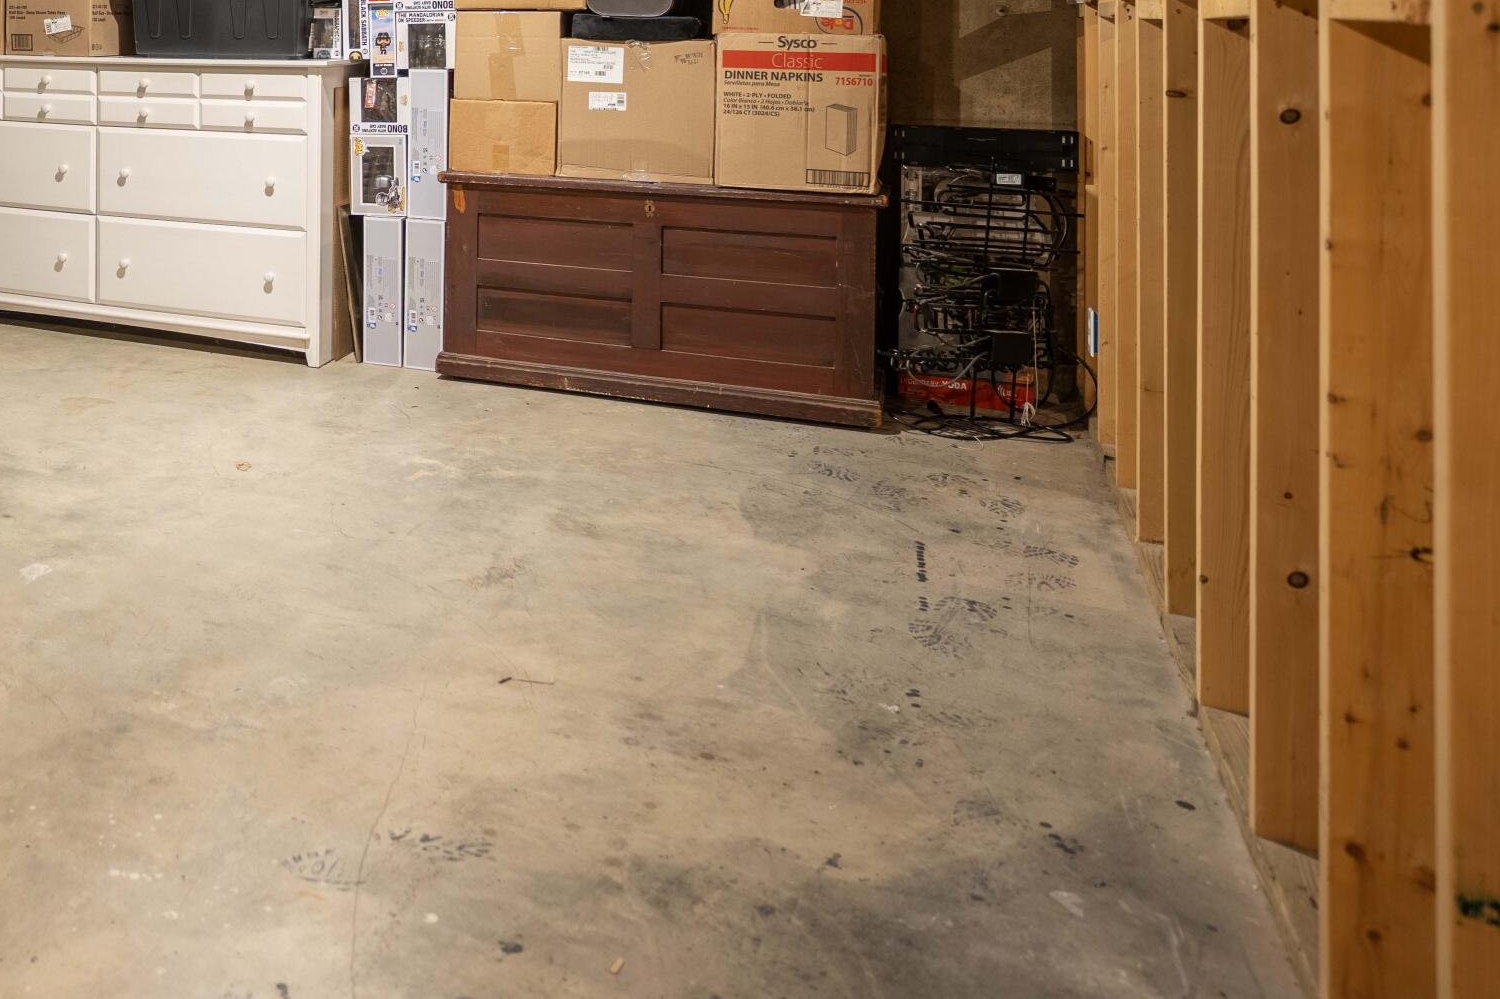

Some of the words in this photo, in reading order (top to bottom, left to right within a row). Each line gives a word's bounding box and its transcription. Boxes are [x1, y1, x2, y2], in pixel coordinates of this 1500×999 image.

[432, 0, 454, 9] BONO
[777, 35, 818, 51] Sysco
[771, 52, 824, 69] Classic
[724, 70, 768, 81] DINNER
[771, 71, 823, 82] NAPKINS
[835, 77, 873, 86] 7156710
[387, 124, 408, 133] BONO
